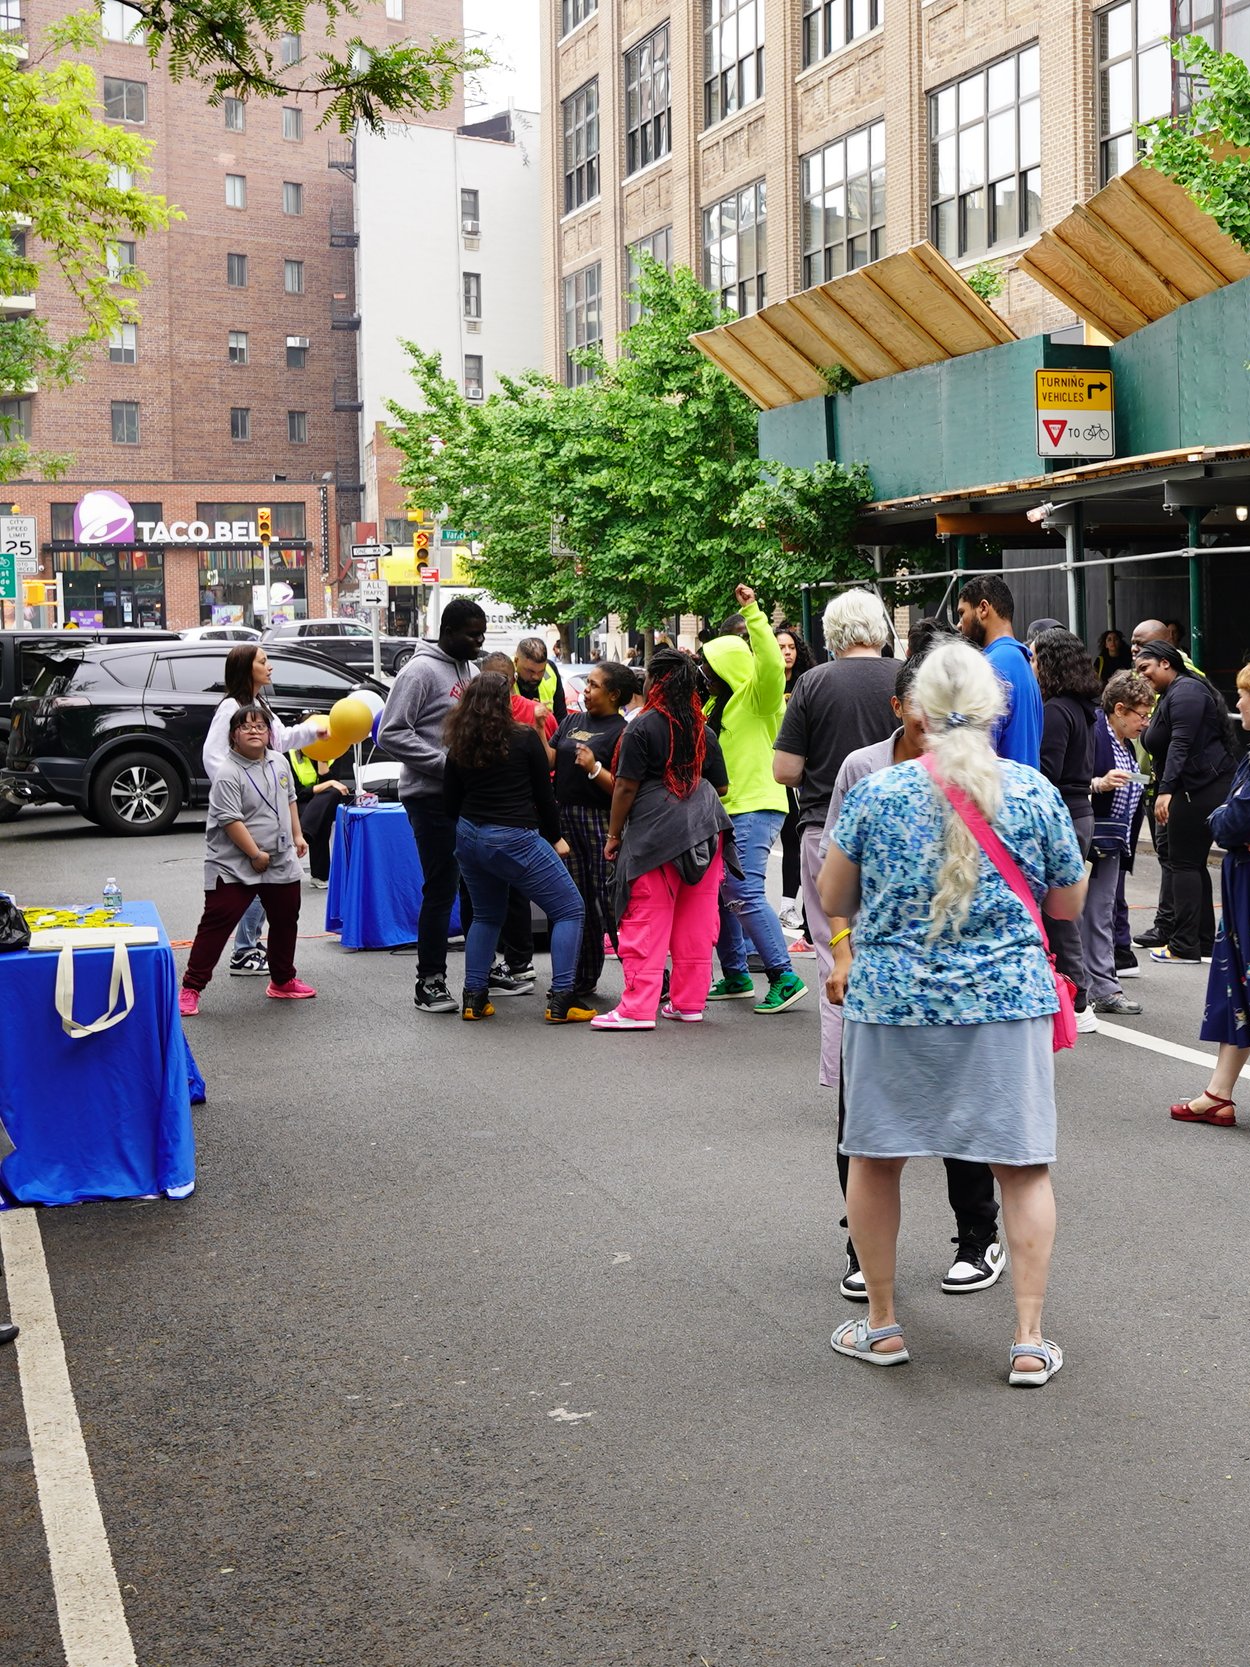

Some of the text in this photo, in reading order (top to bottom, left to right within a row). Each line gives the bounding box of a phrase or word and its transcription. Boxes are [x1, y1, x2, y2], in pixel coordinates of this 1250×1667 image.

[1041, 377, 1084, 388] TURNING
[1042, 392, 1084, 402] VEHICLES
[1068, 427, 1080, 438] TO
[137, 521, 209, 542] TACO
[5, 540, 32, 556] 25
